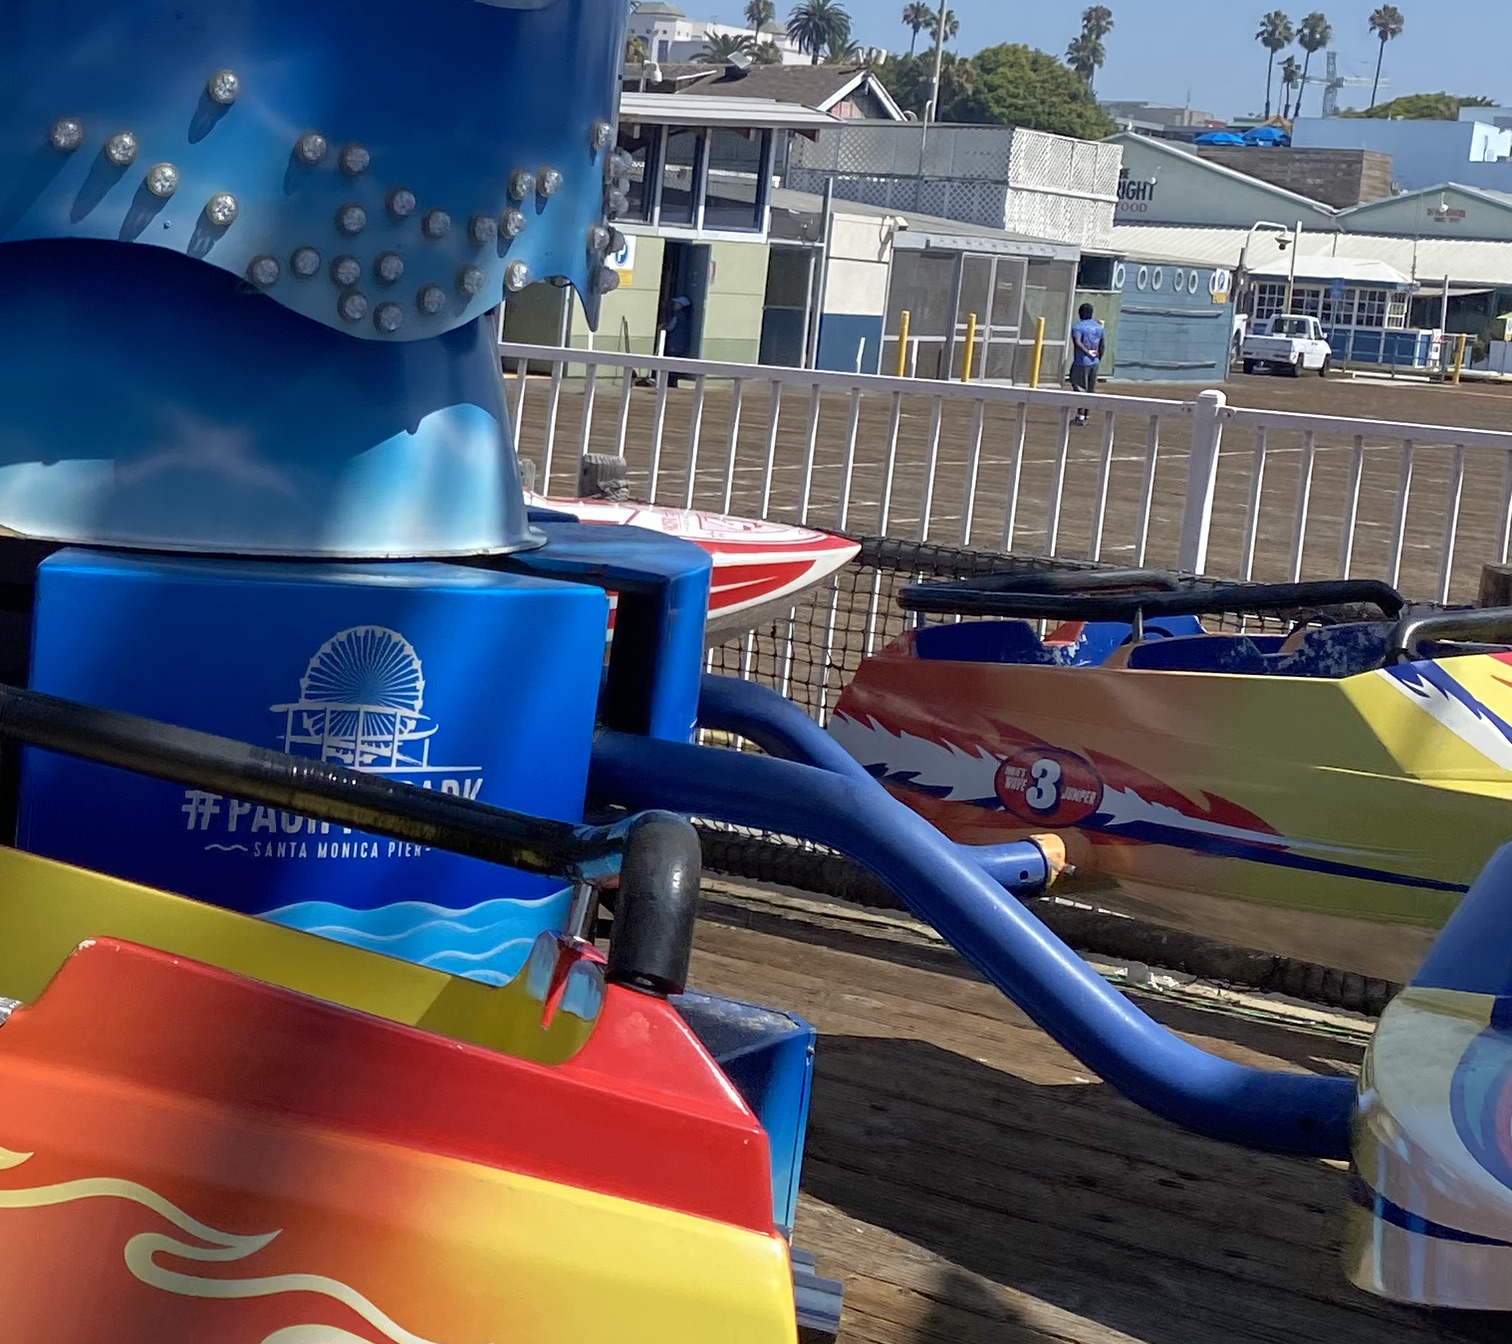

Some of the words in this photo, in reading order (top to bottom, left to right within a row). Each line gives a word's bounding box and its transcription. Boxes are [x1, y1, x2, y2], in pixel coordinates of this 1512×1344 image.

[1026, 758, 1061, 809] 3
[1061, 786, 1097, 805] JUMPER
[254, 841, 308, 858] SANTA
[317, 841, 379, 858] MONICA
[388, 841, 422, 858] PIER
